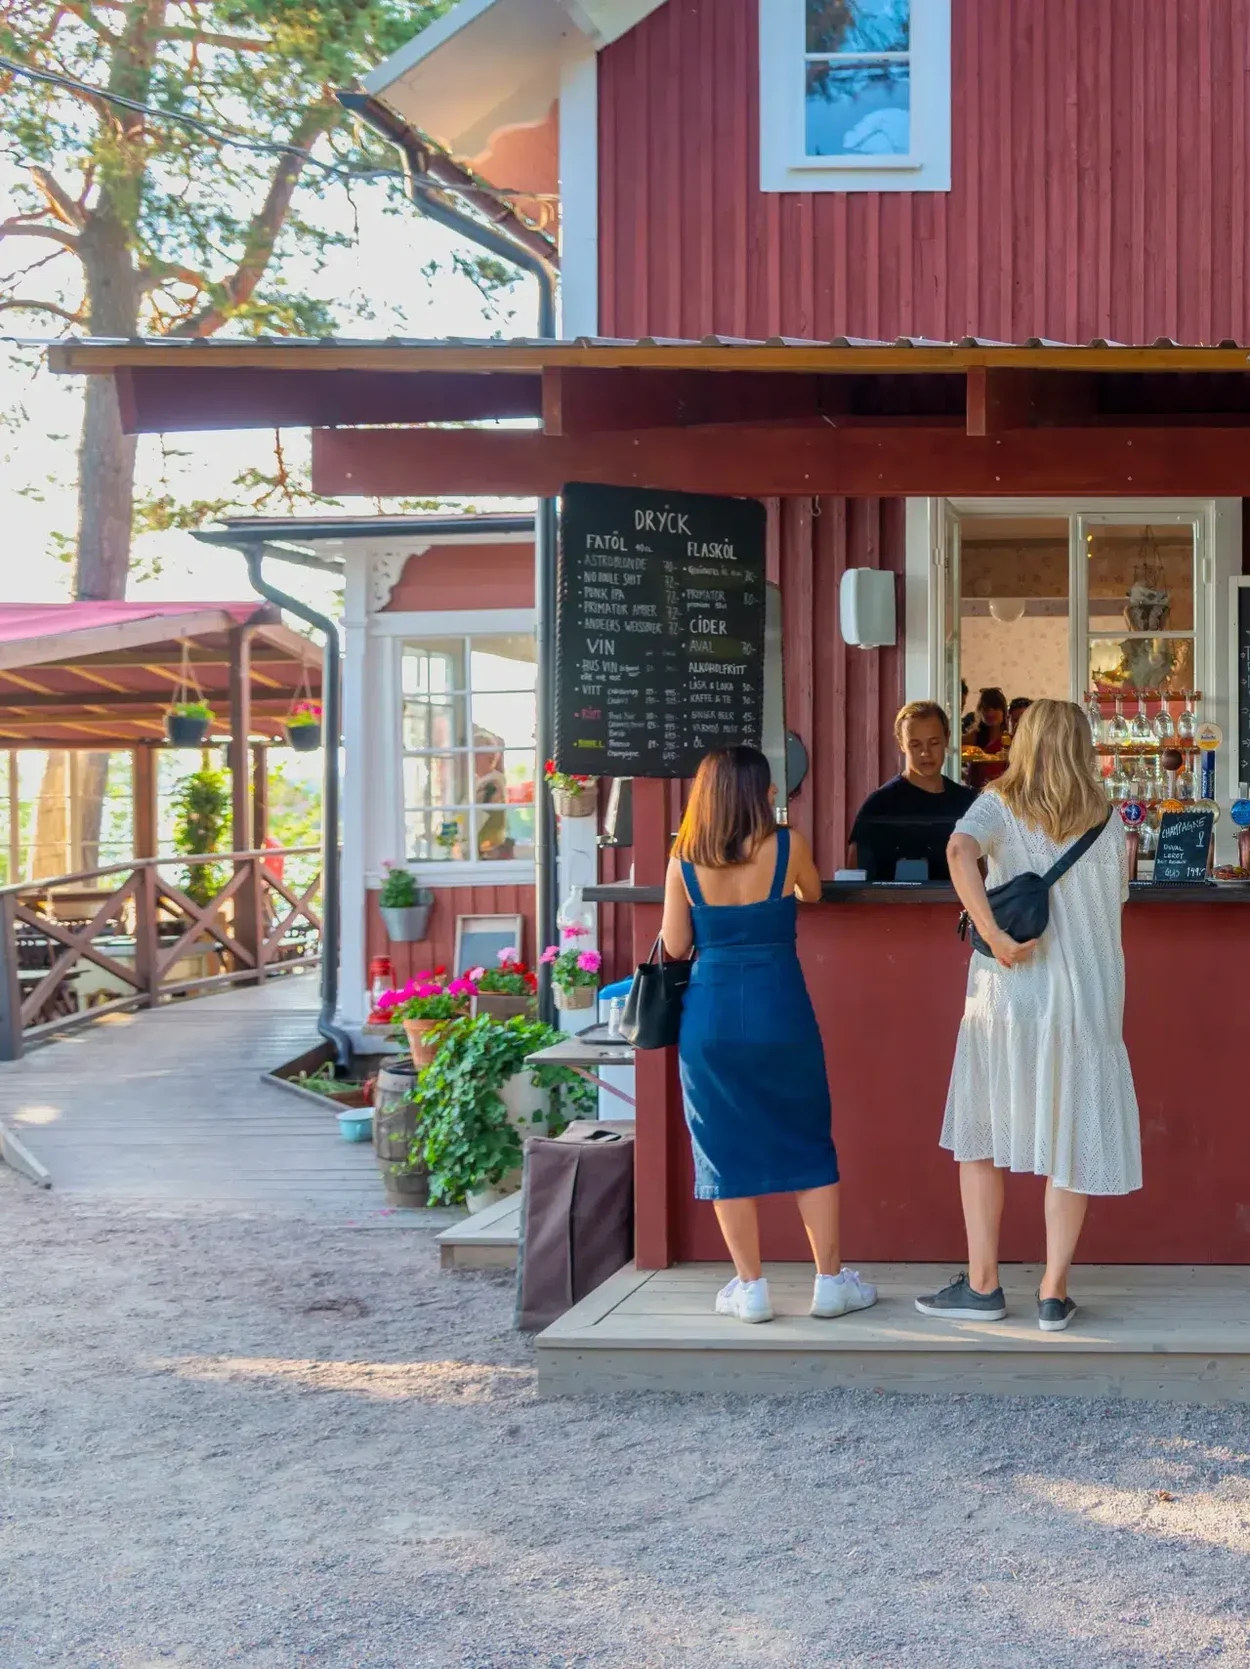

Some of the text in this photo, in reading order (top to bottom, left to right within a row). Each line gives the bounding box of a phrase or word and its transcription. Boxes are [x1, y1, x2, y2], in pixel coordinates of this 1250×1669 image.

[634, 508, 692, 536] DRYCK
[586, 530, 628, 551] FATÖL
[687, 538, 737, 560] FLASKÖL
[690, 614, 728, 635] CIDER
[586, 635, 615, 656] VIN
[688, 662, 748, 676] ALKOHOLFRITT
[582, 684, 603, 696] VITT
[690, 693, 714, 703] KAFFE
[1161, 816, 1207, 839] CHAMPAGNE
[1163, 844, 1184, 852] DUVAL
